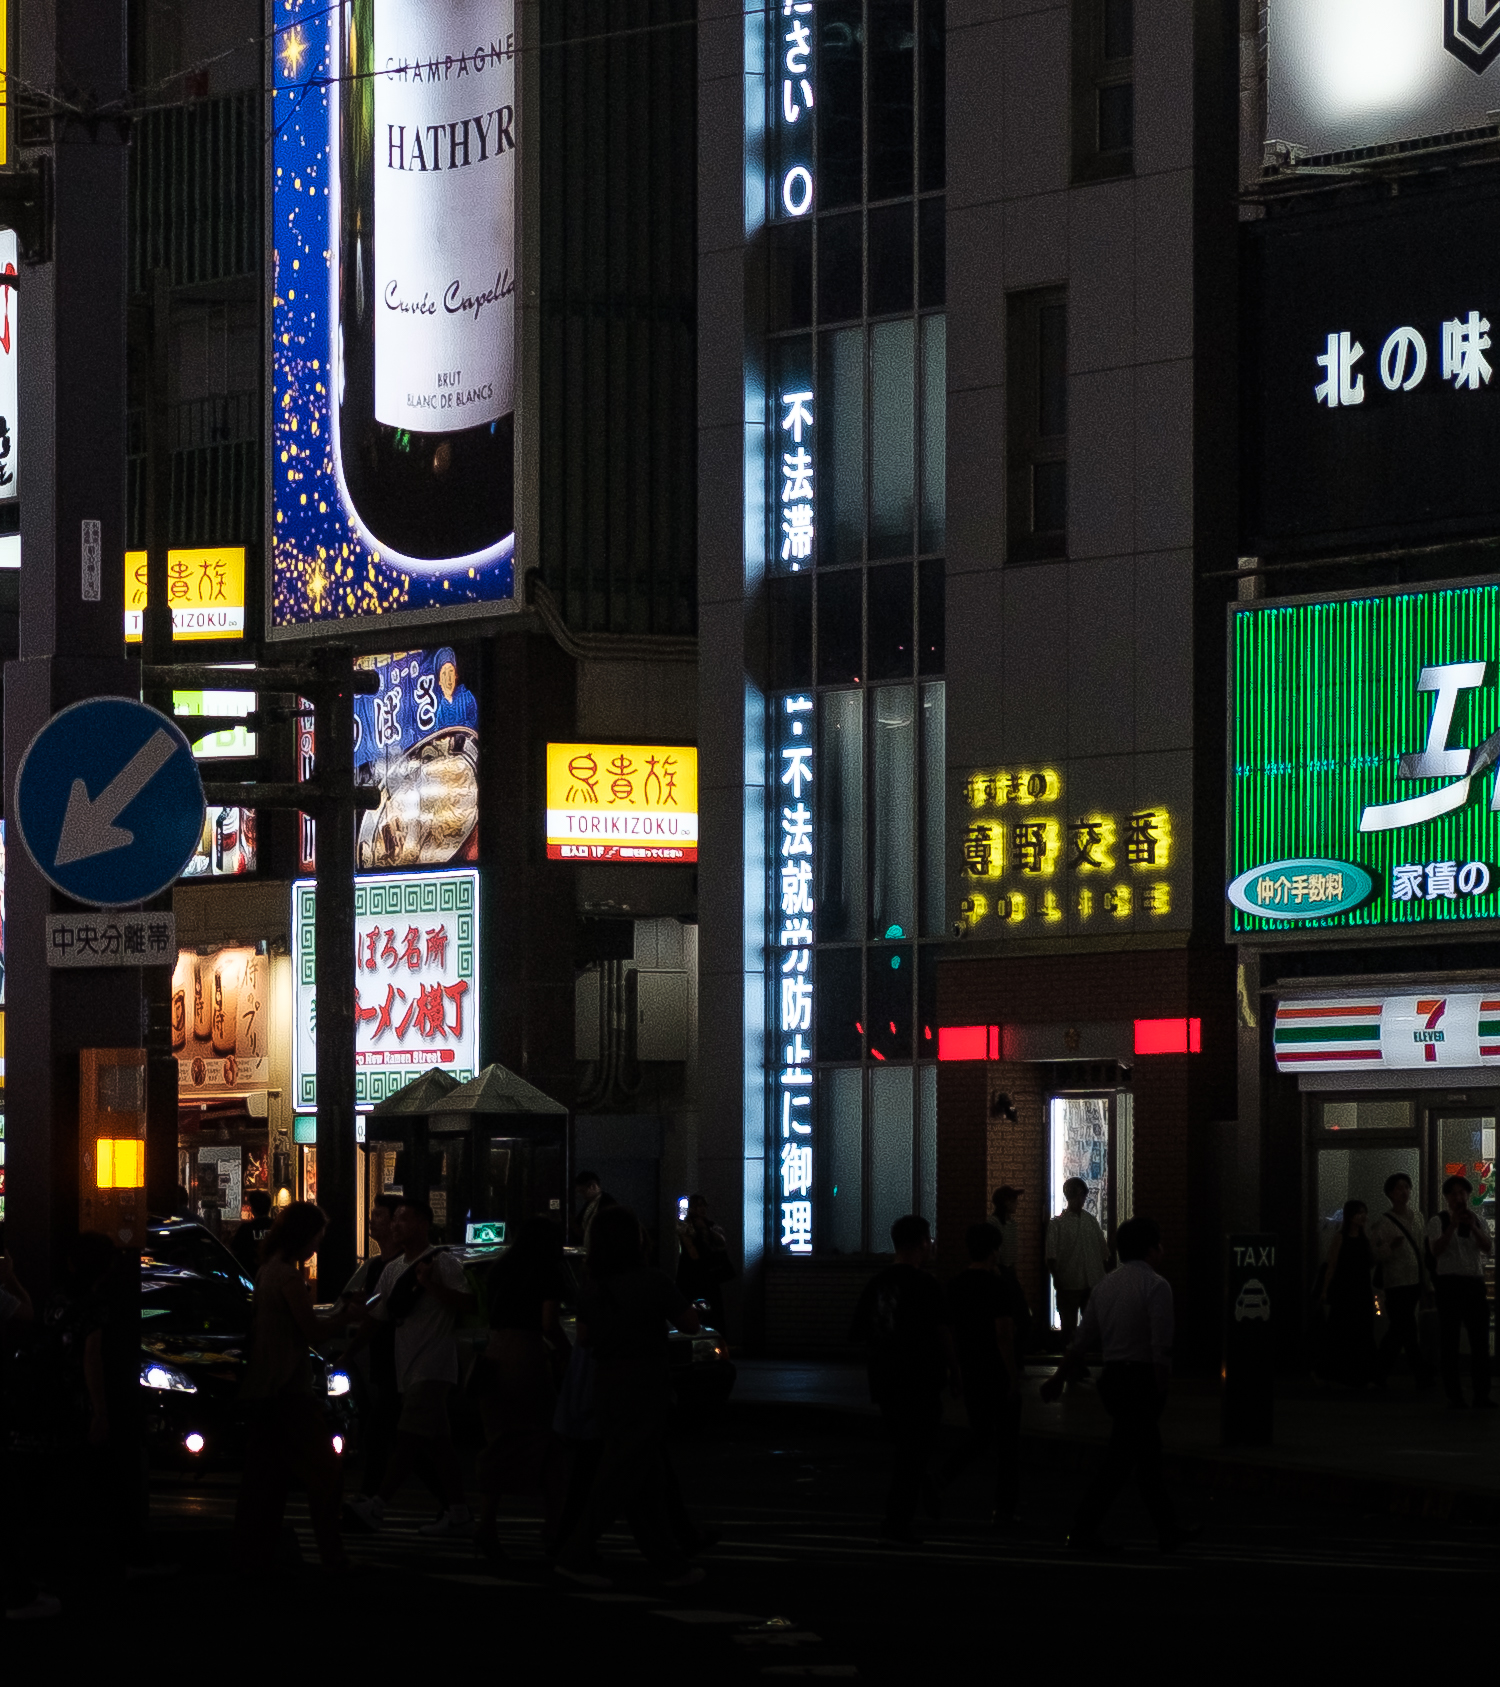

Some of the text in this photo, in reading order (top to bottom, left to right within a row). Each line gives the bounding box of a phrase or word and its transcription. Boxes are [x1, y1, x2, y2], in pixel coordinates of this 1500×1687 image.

[385, 30, 514, 82] CHAMPAGNE
[386, 104, 514, 173] HATHYR
[437, 370, 462, 389] BRUT
[440, 388, 454, 407] DE
[566, 815, 678, 836] TORIKIZOKU
[1257, 873, 1344, 904] 仲介手数料
[1393, 861, 1490, 901] 家賃の
[51, 922, 170, 957] 中央分離帯
[355, 979, 469, 1042] ーメン横丁
[1233, 1246, 1276, 1268] TAXI
